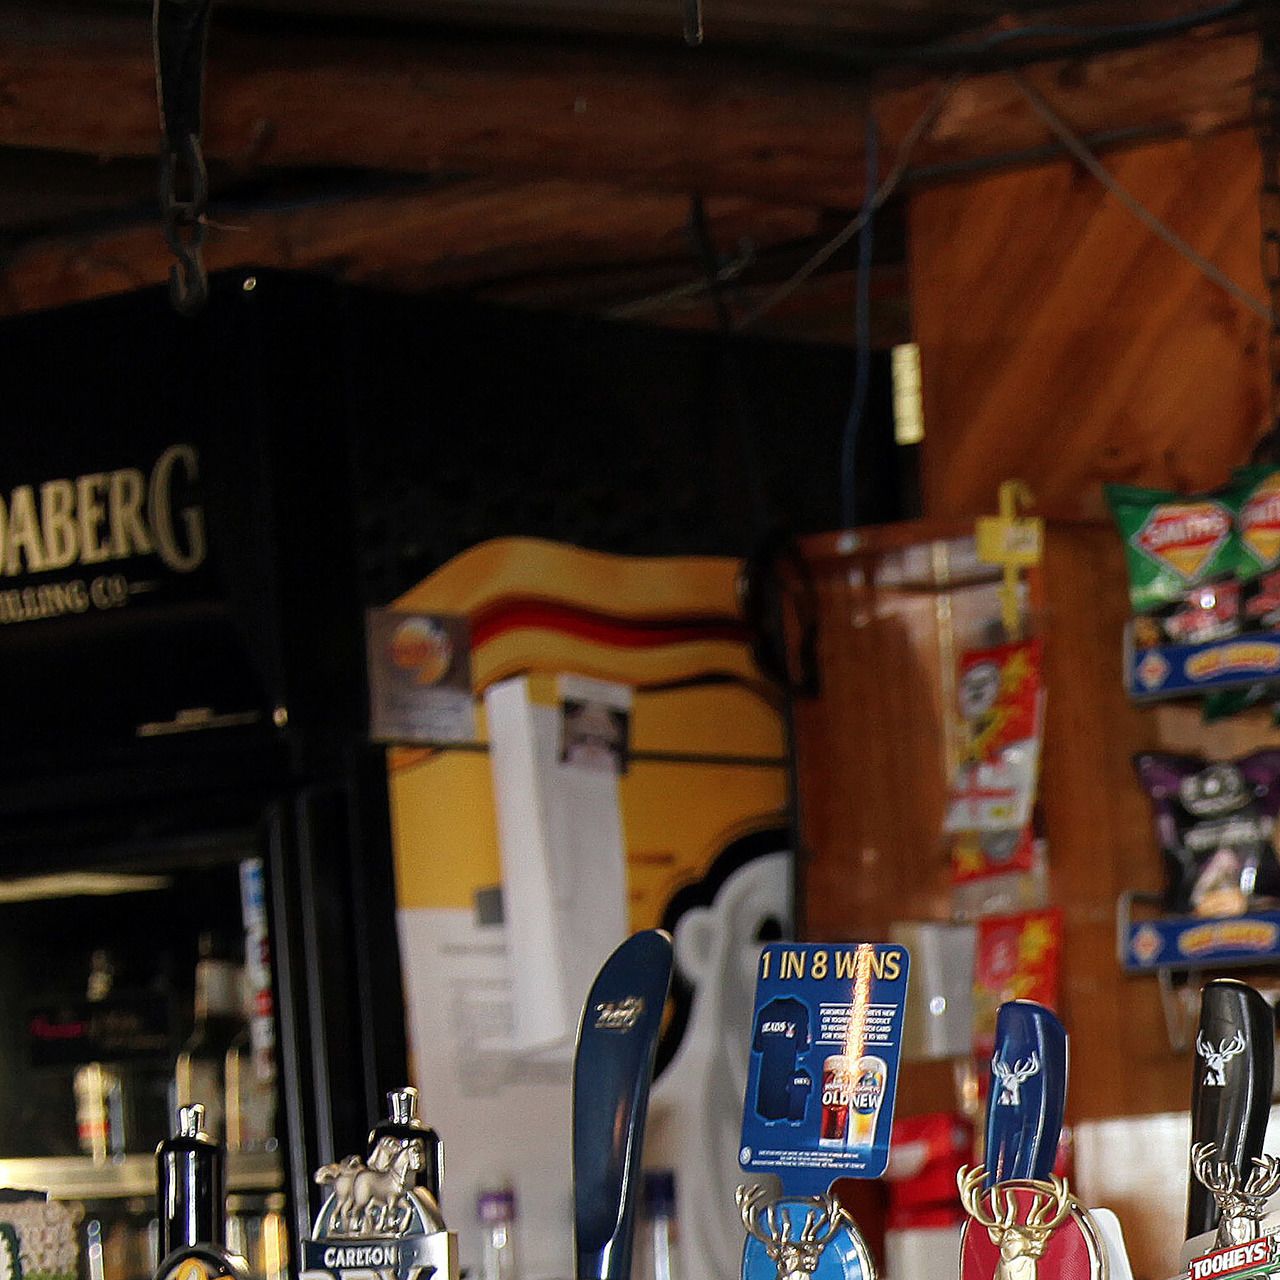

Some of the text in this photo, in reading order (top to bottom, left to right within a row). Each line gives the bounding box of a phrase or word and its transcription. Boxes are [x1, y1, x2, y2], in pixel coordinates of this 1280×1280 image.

[0, 443, 207, 577] ABERG
[762, 951, 771, 979] 1
[779, 951, 806, 979] IN
[811, 950, 829, 980] 8
[822, 1091, 849, 1105] OLD
[324, 1246, 396, 1268] CARLTON
[1192, 1241, 1267, 1280] TOOHEYS
